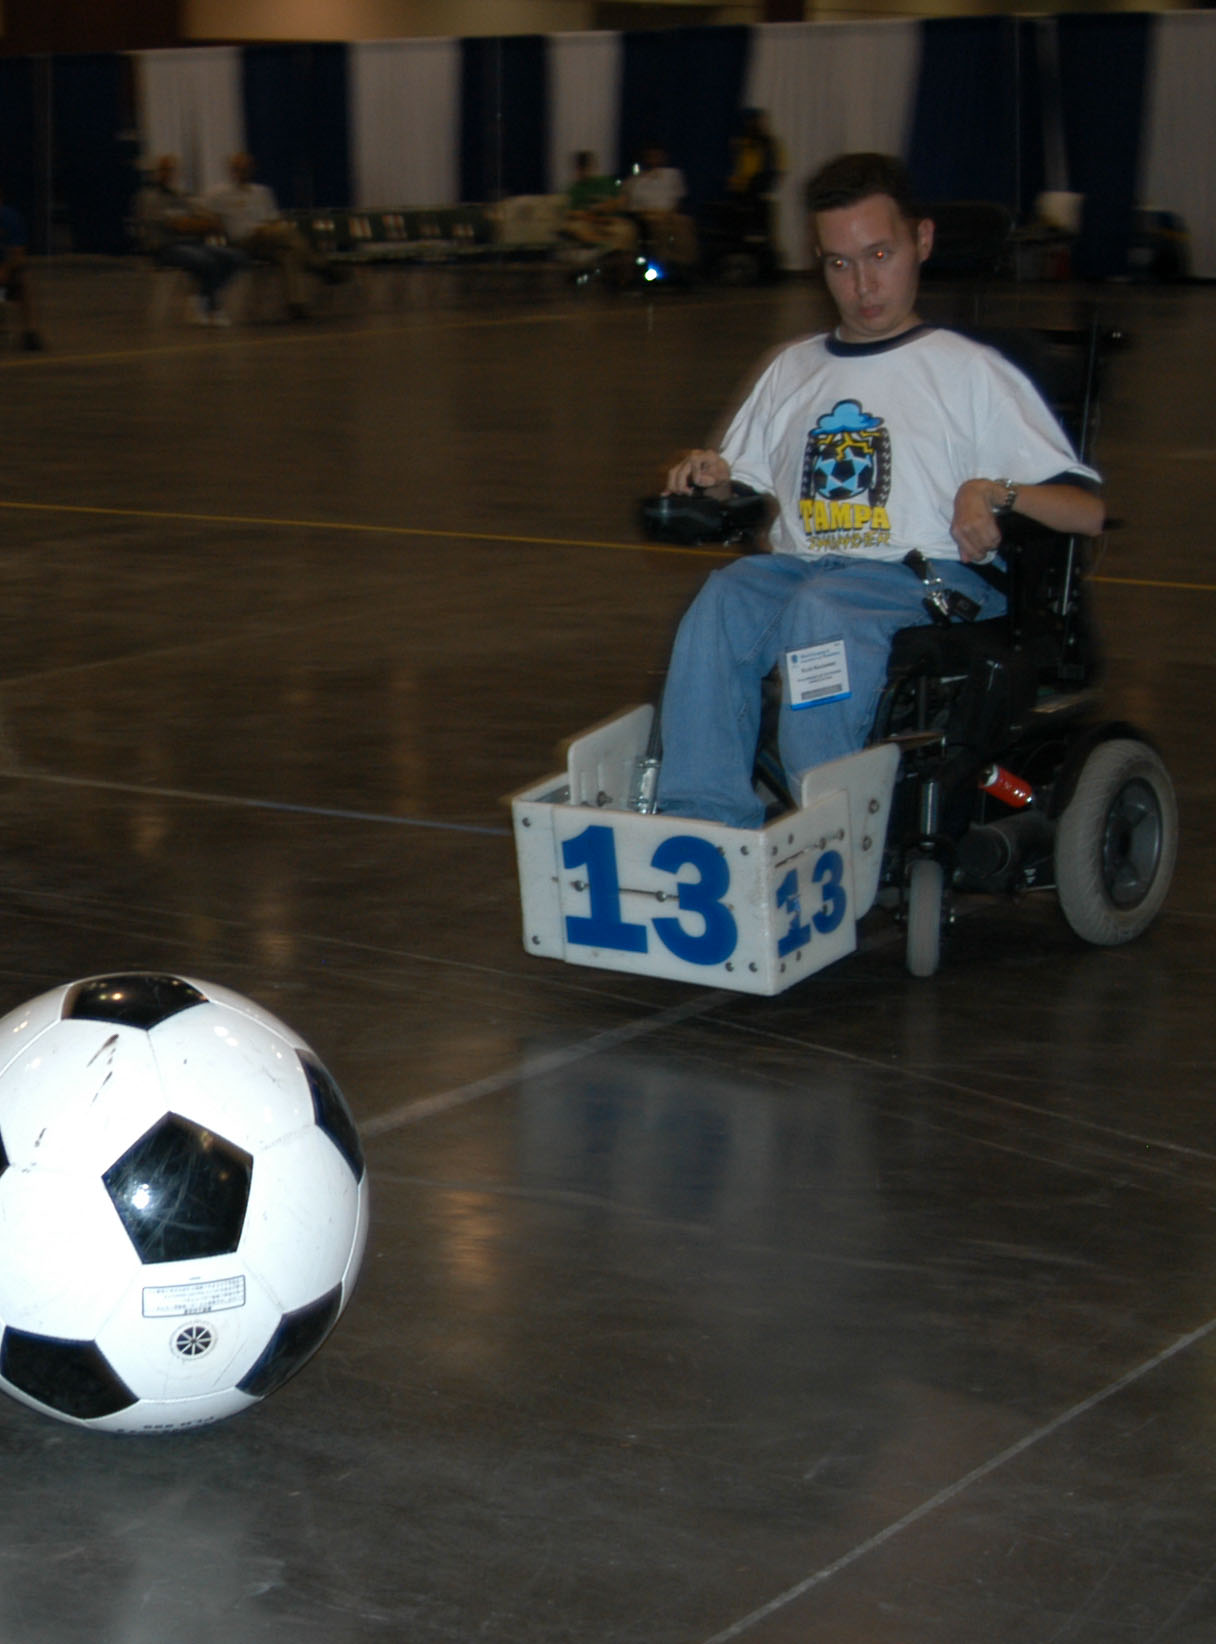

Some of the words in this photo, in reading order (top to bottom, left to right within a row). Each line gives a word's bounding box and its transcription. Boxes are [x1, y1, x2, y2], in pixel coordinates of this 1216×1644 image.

[799, 499, 891, 535] TAMPA
[561, 824, 739, 966] 13
[775, 849, 848, 958] 13
